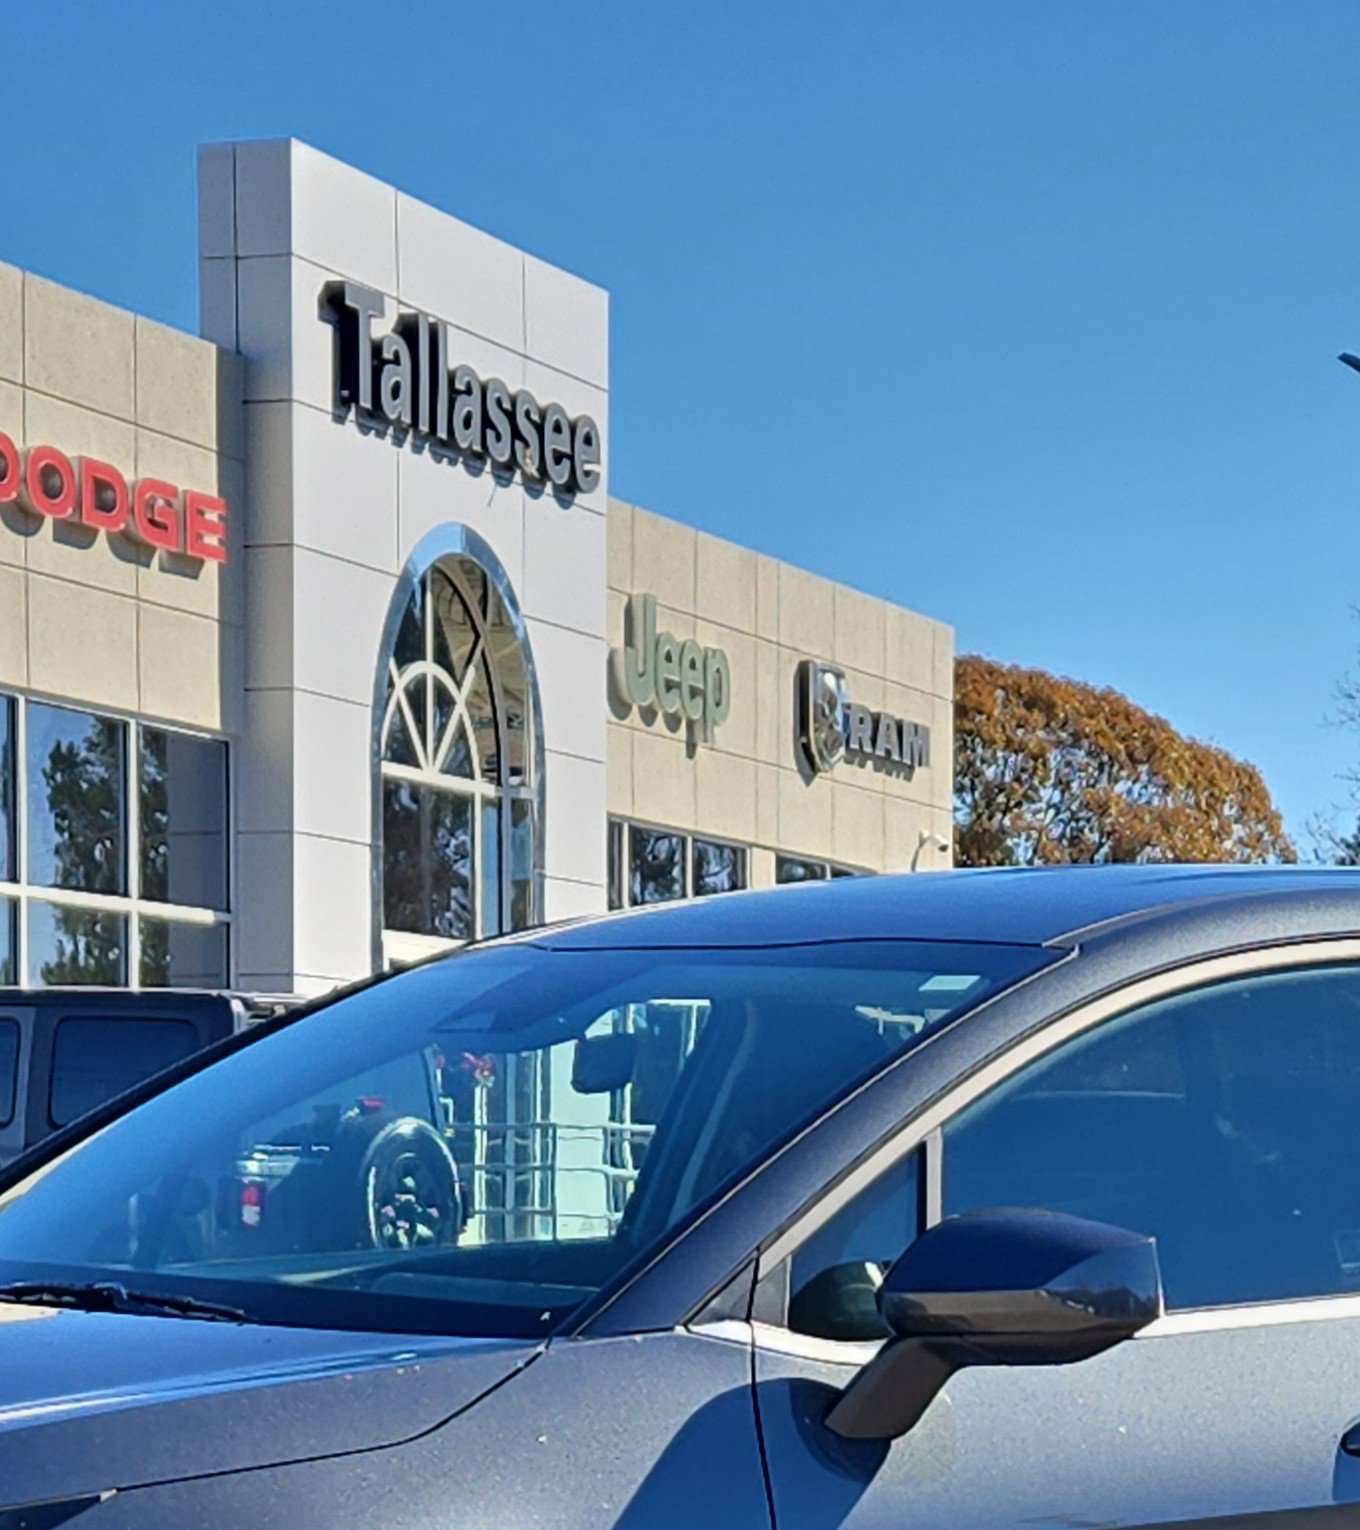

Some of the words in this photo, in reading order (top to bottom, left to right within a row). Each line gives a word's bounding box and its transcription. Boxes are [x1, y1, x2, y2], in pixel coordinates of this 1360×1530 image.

[336, 281, 601, 493] Tallassee
[624, 592, 731, 750] Jeep
[848, 703, 930, 768] RAM
